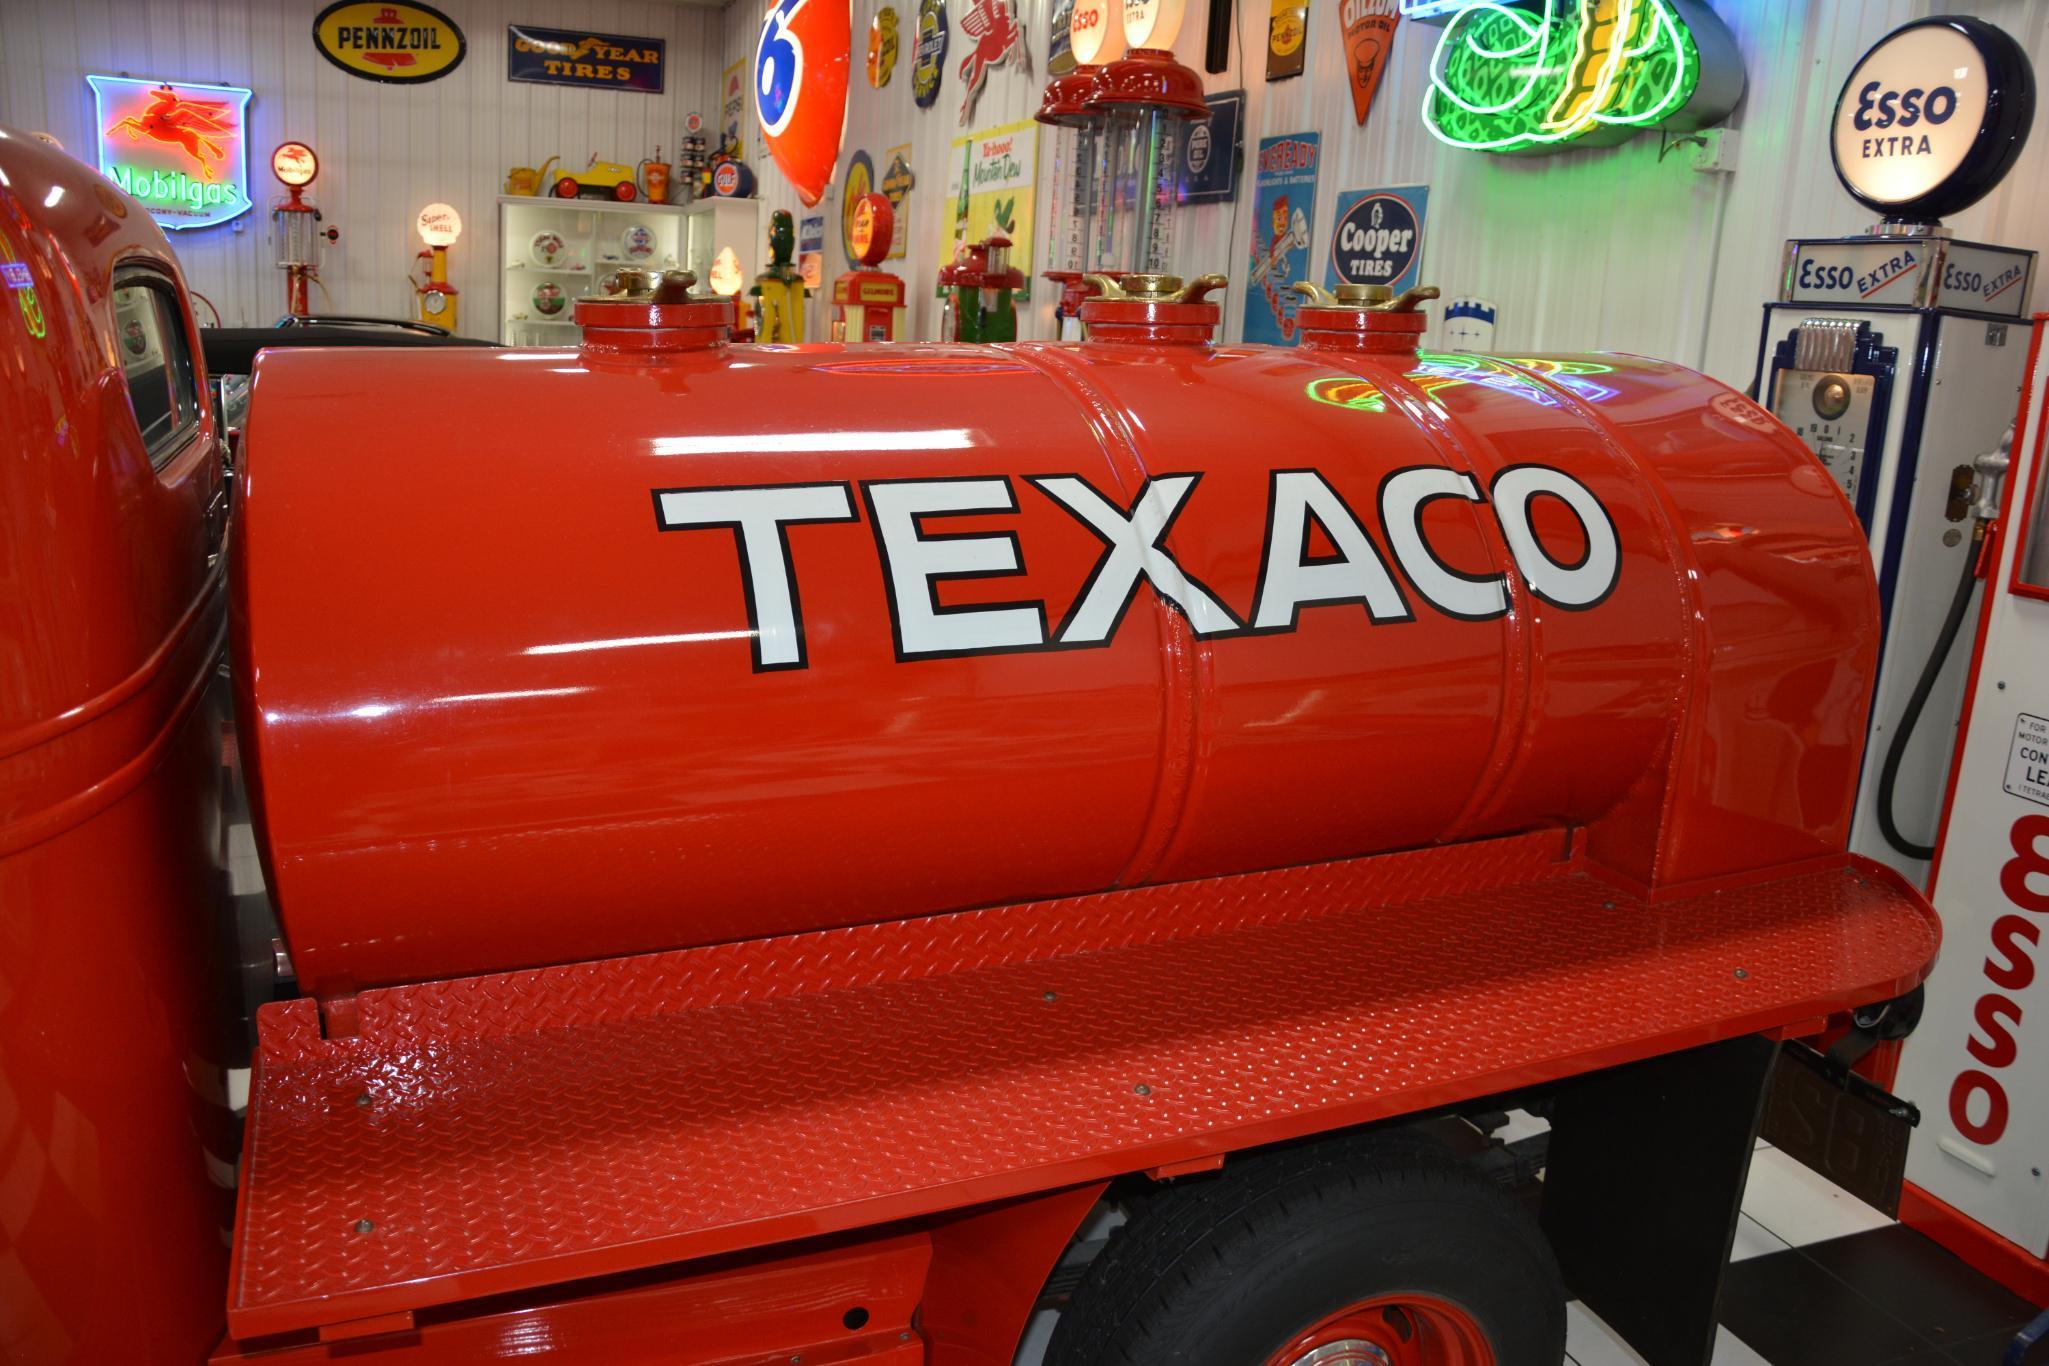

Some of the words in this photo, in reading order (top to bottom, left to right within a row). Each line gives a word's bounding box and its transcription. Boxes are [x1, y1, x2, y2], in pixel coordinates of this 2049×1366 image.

[338, 26, 441, 50] PENNZOIL
[1348, 20, 1376, 38] MOTOR
[1378, 22, 1391, 32] OIL
[544, 60, 632, 81] TIRES
[1257, 139, 1317, 173] EVEREADY
[1862, 135, 1932, 158] EXTRA
[108, 166, 238, 210] Mobilgas
[1340, 221, 1413, 258] Cooper
[1350, 260, 1393, 277] TIRES
[1856, 250, 1916, 294] EXTRA
[1982, 265, 2022, 297] EXTRA
[1849, 433, 1855, 443] 2
[1850, 451, 1856, 460] 3
[1849, 465, 1854, 475] 4
[651, 463, 1622, 673] TEXACO
[2019, 731, 2048, 745] MOTOR
[2029, 722, 2047, 733] FOR
[2026, 766, 2049, 786] LE
